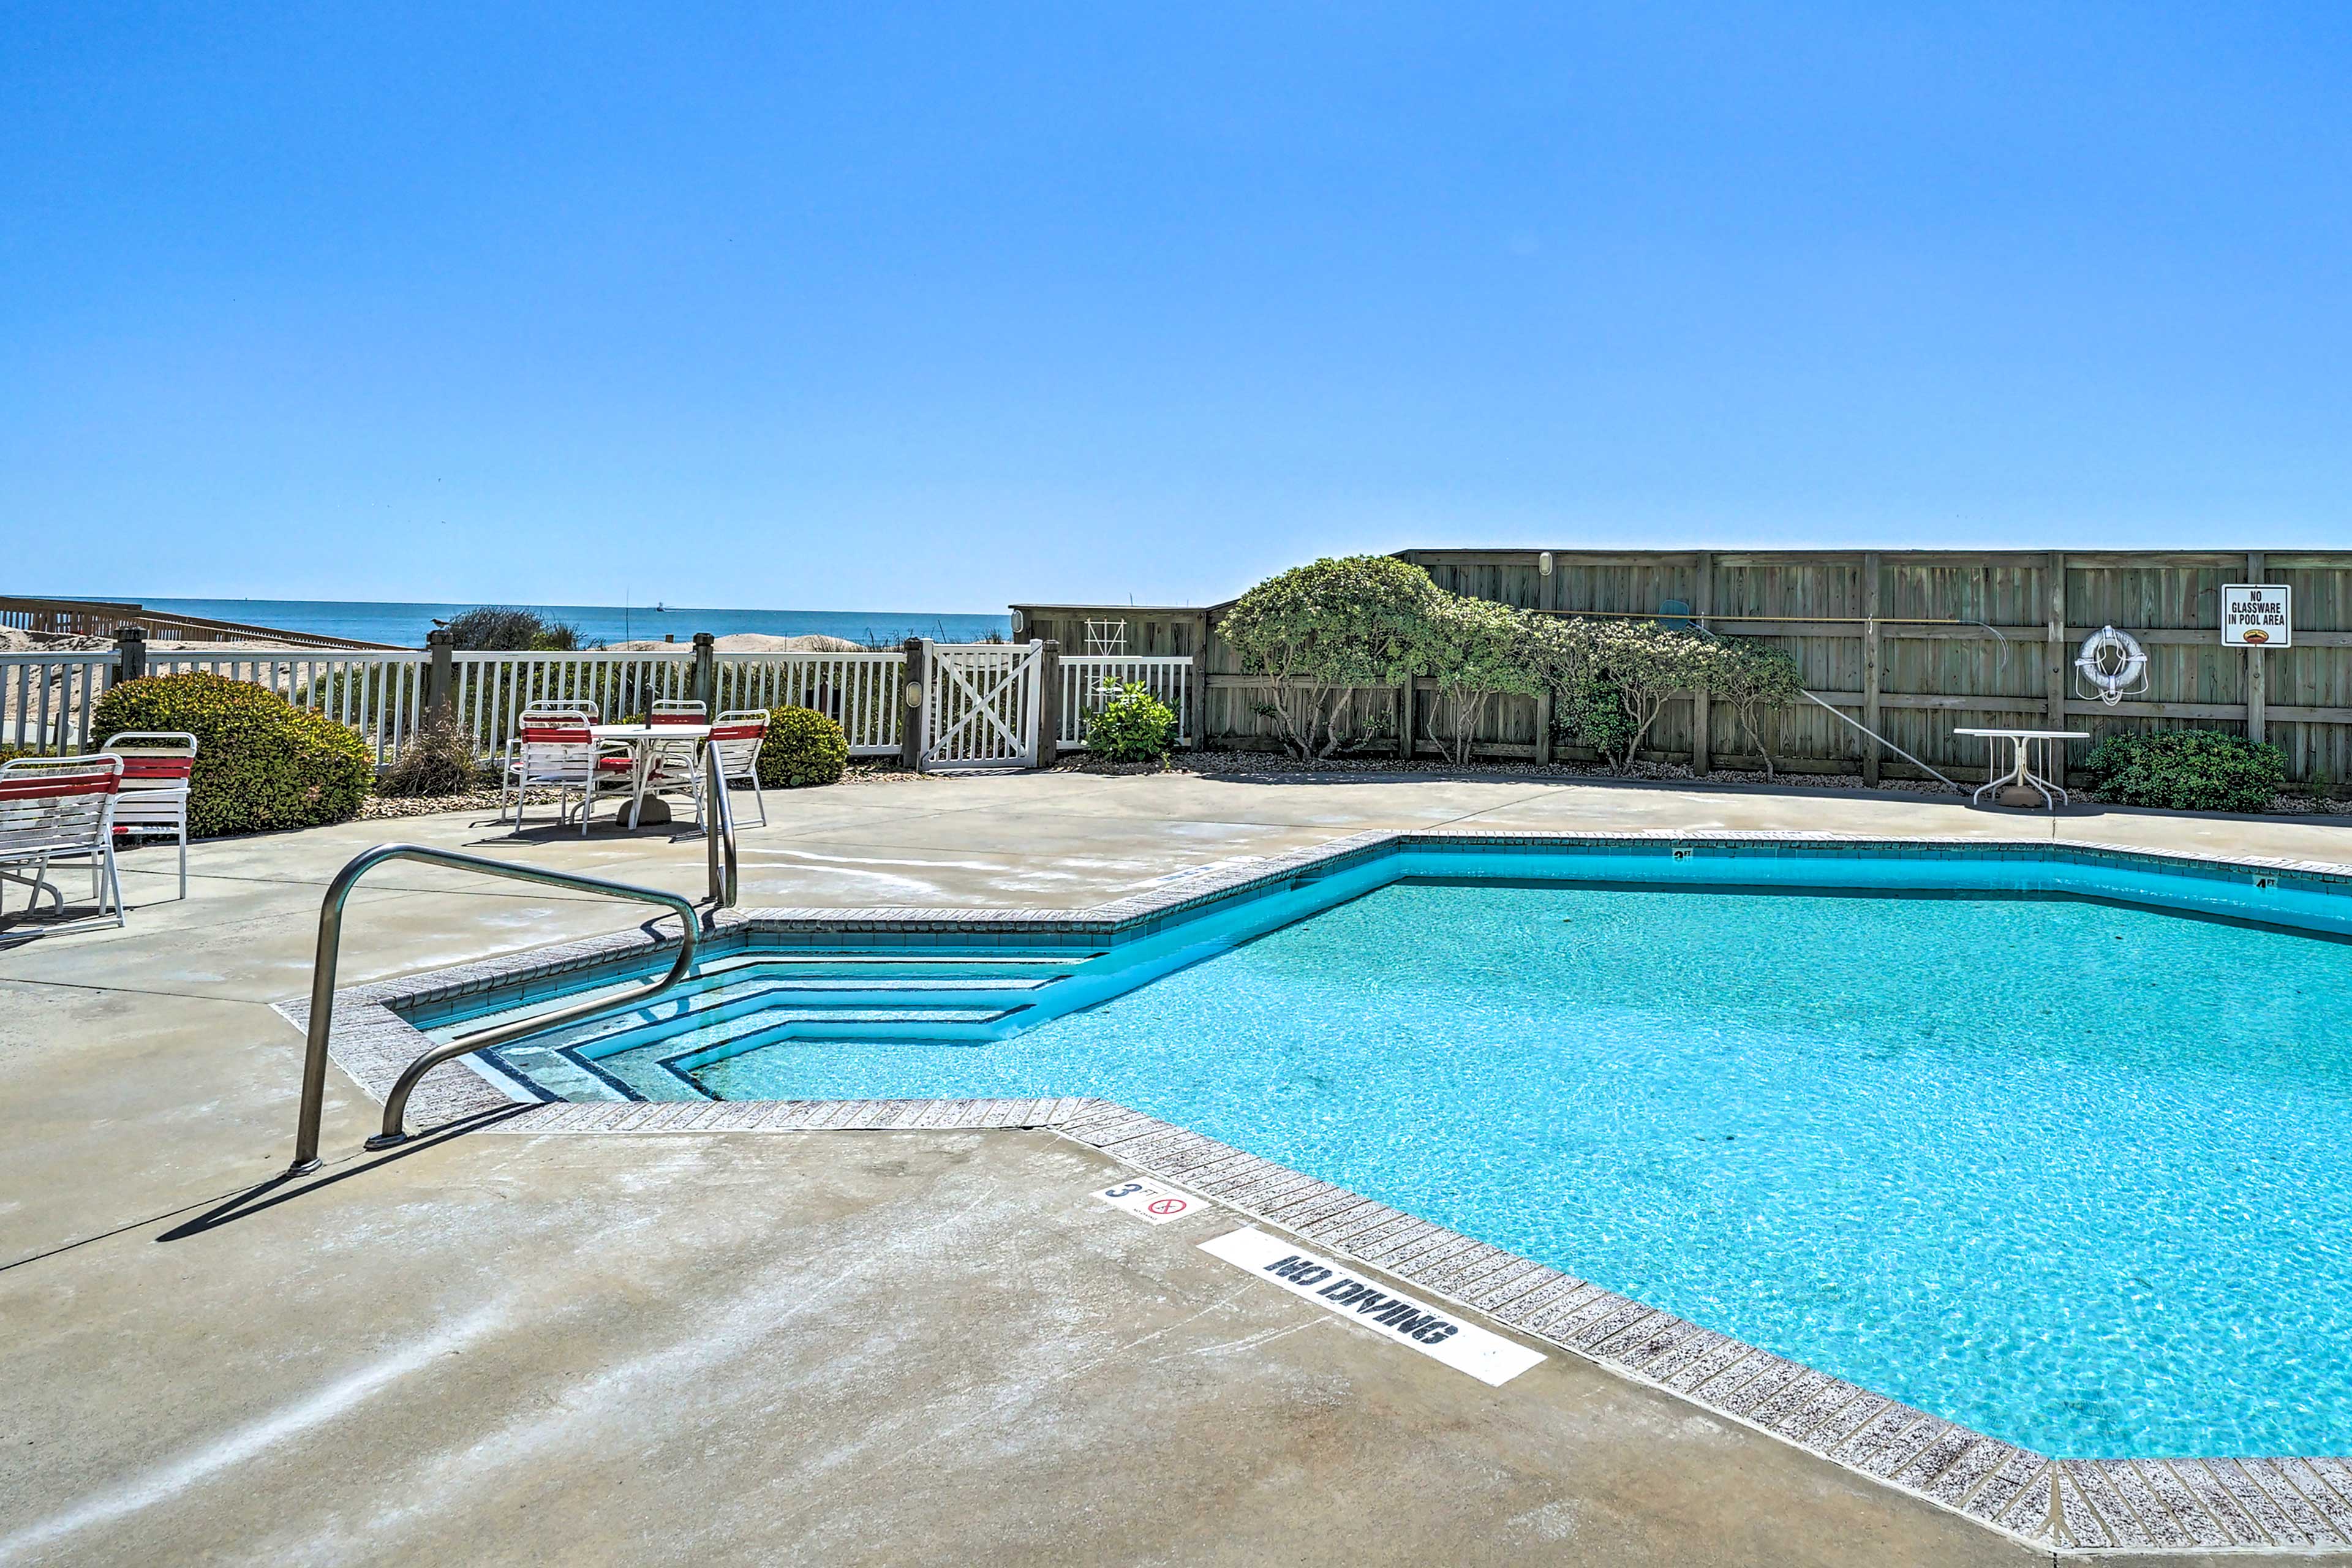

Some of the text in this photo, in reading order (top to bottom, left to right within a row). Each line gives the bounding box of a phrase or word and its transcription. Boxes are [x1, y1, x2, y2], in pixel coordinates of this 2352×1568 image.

[2250, 590, 2262, 602] NO
[2231, 602, 2281, 614] GLASSWARE
[2228, 614, 2285, 626] IN POOL AREA
[1105, 1184, 1142, 1197] 3
[1263, 1255, 1458, 1344] NO DIVING
